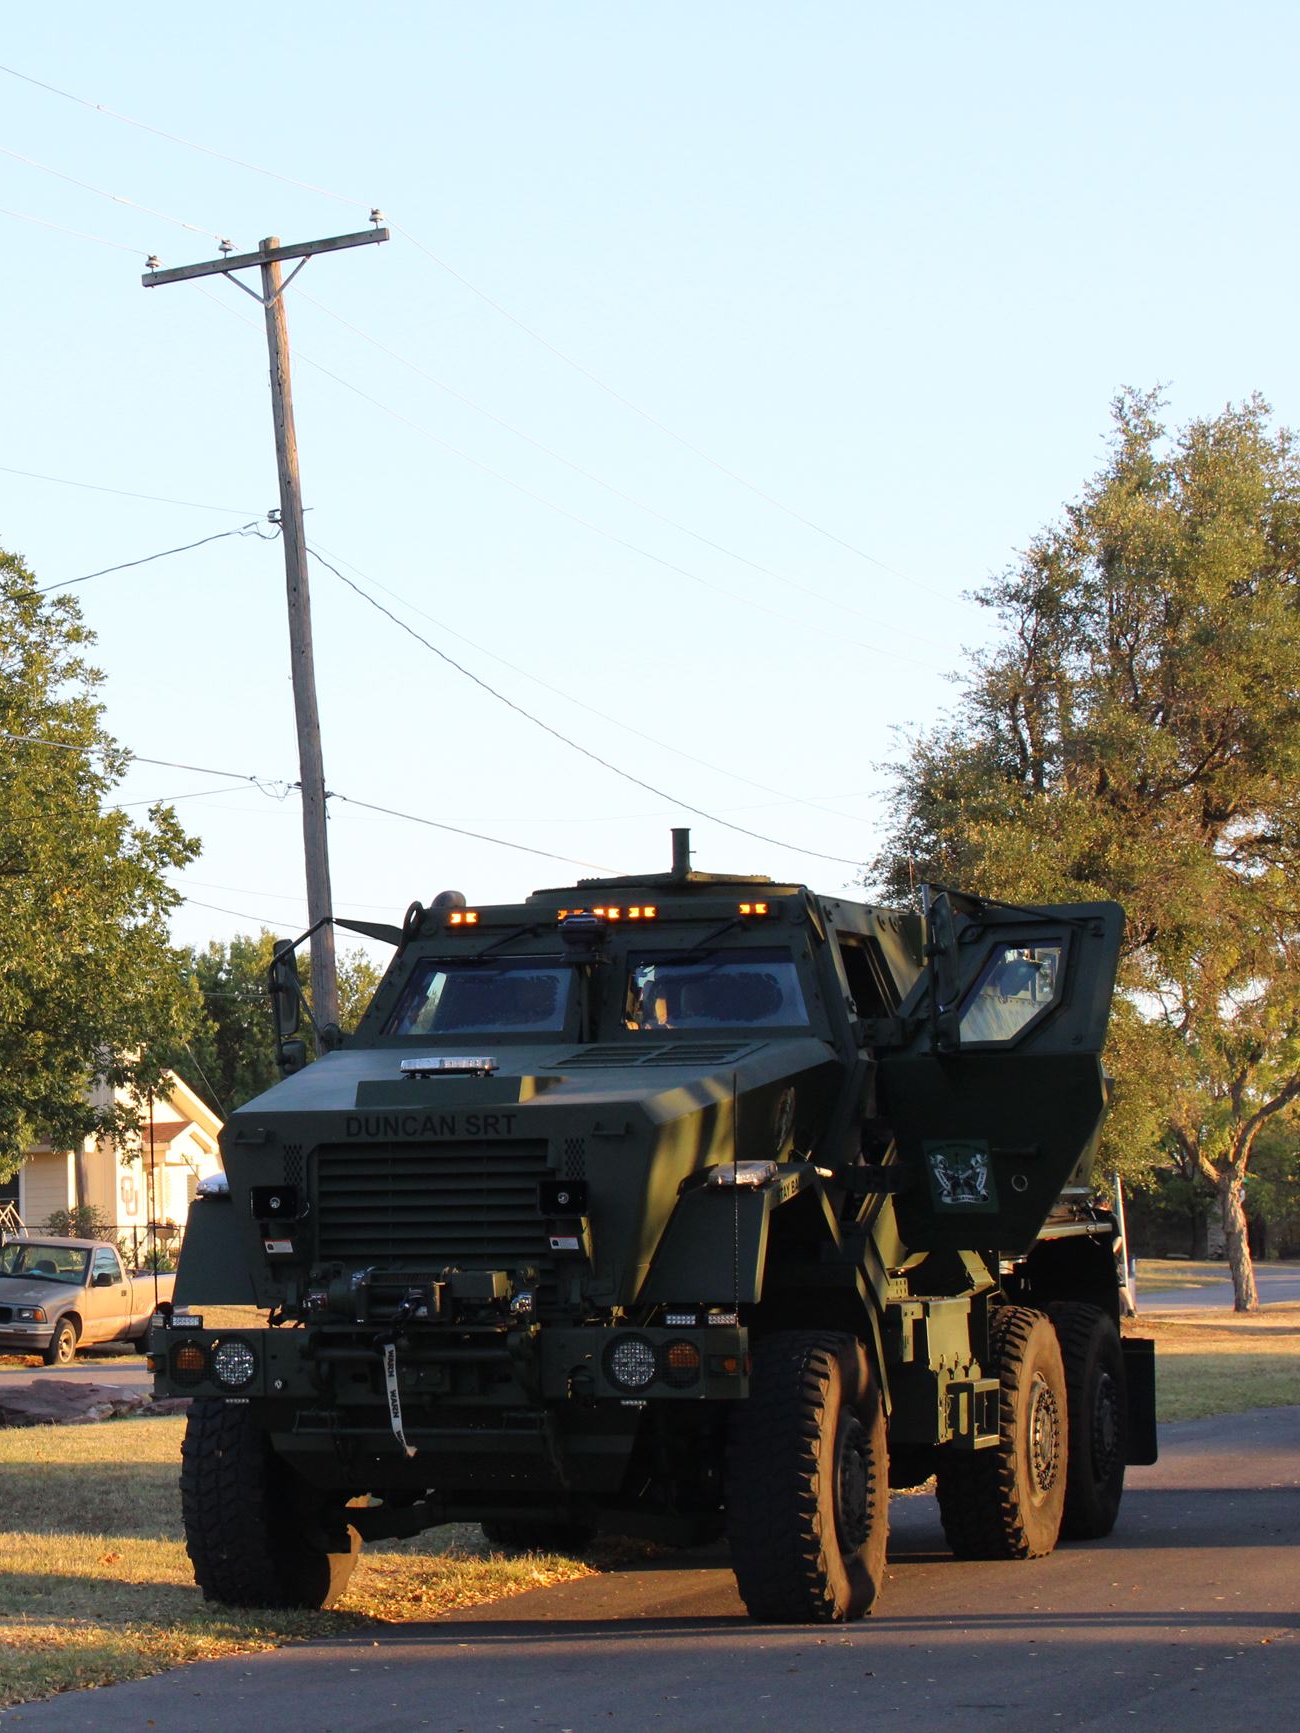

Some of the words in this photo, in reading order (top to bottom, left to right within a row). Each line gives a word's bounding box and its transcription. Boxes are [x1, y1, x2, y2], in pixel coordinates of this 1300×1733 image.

[345, 1115, 455, 1137] DUNCAN
[465, 1114, 517, 1135] SRT
[121, 1175, 139, 1217] OU
[387, 1349, 395, 1378] WARN
[390, 1389, 399, 1419] WARN
